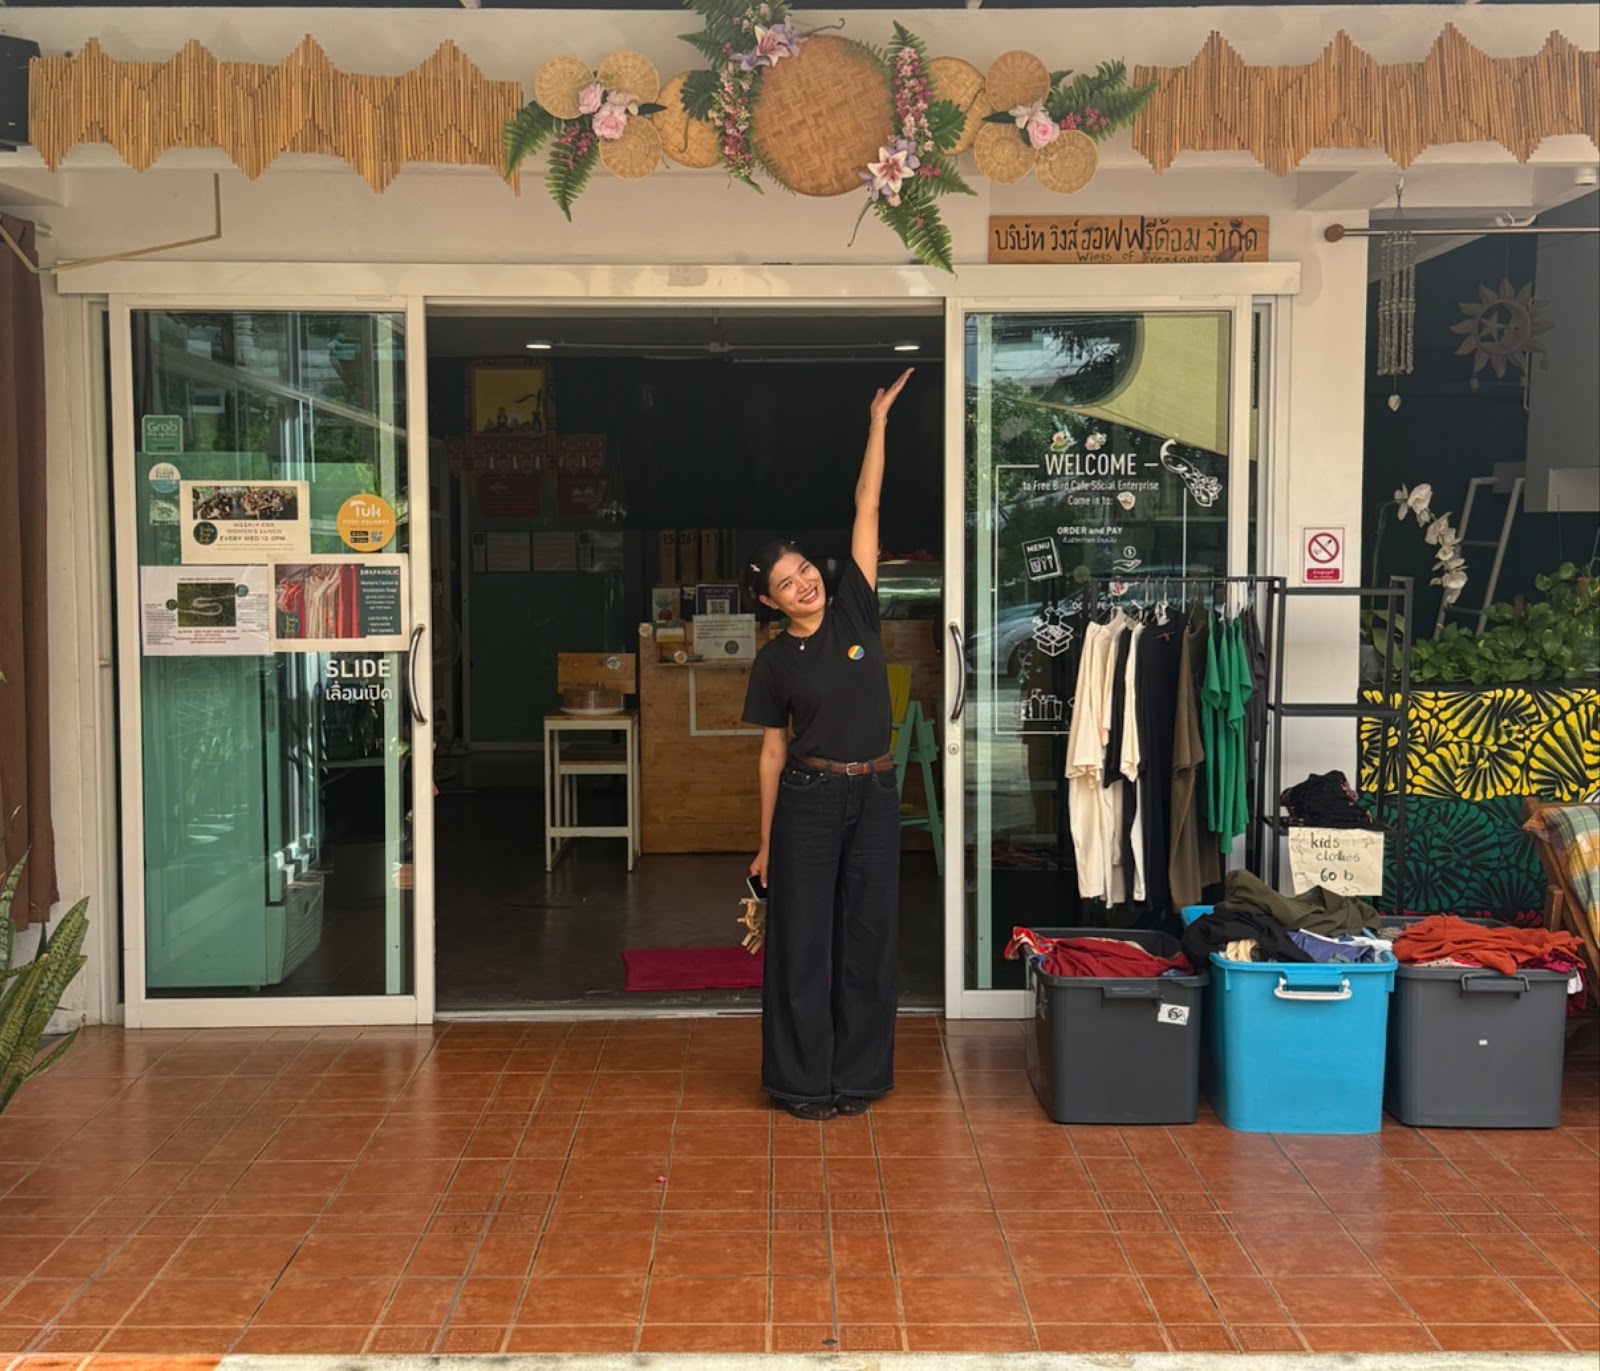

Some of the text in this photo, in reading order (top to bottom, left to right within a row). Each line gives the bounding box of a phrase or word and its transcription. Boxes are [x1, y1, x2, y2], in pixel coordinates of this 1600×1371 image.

[994, 223, 1045, 252] บริษัท
[1077, 251, 1112, 263] Wings
[1121, 250, 1135, 260] of
[147, 421, 178, 432] Grab
[1044, 453, 1137, 476] WELCOME
[1023, 481, 1031, 490] to
[1033, 481, 1051, 490] Free
[1053, 481, 1069, 490] Bird
[1091, 481, 1116, 490] Social
[1118, 480, 1159, 491] Enterprise
[1067, 495, 1090, 505] Come
[1091, 495, 1100, 505] in
[350, 500, 381, 517] Tuk
[1057, 526, 1123, 535] ORDER and PAY
[1026, 541, 1051, 553] MENU
[325, 659, 391, 678] SLIDE
[326, 680, 393, 701] เลื่อนเปิด
[1310, 832, 1340, 849] kids
[1320, 867, 1354, 882] 60 b
